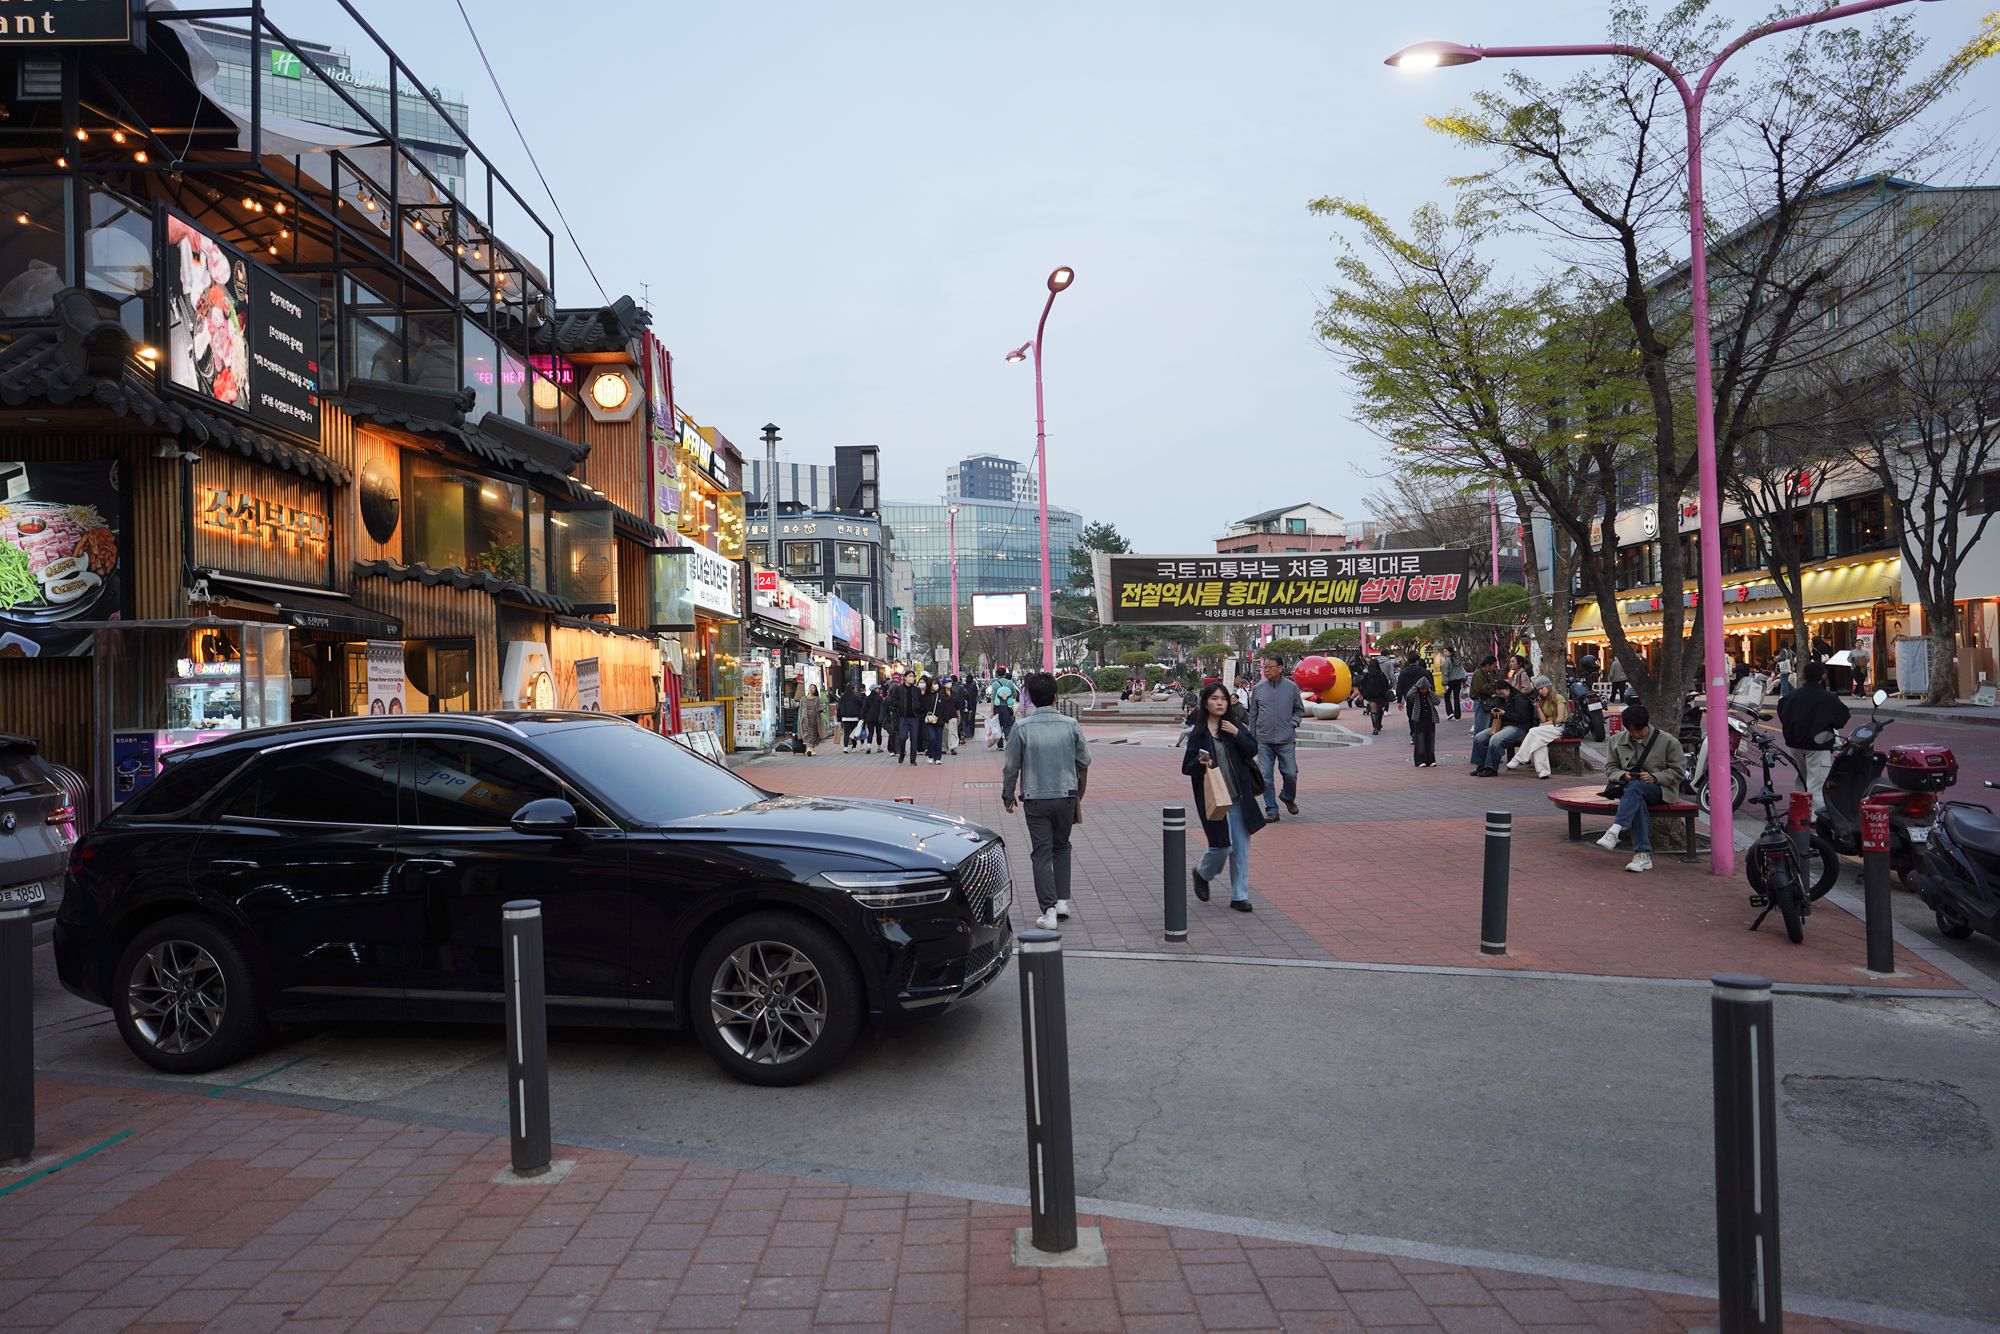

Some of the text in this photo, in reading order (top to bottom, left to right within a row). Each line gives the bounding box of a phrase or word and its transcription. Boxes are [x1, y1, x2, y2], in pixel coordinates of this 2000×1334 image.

[783, 525, 800, 534] 호수
[837, 525, 869, 537] 반지공방
[689, 553, 729, 592] 홍대순대천국
[1157, 555, 1421, 580] 국토교통부는 처음 계획대로
[759, 577, 772, 586] 24
[1120, 573, 1462, 608] 전철역사를 홍대 사거리에 설치 하라!
[1205, 606, 1370, 618] 대장홍대선 레드로드역사반대 비상대책위원회
[14, 883, 42, 902] 3850
